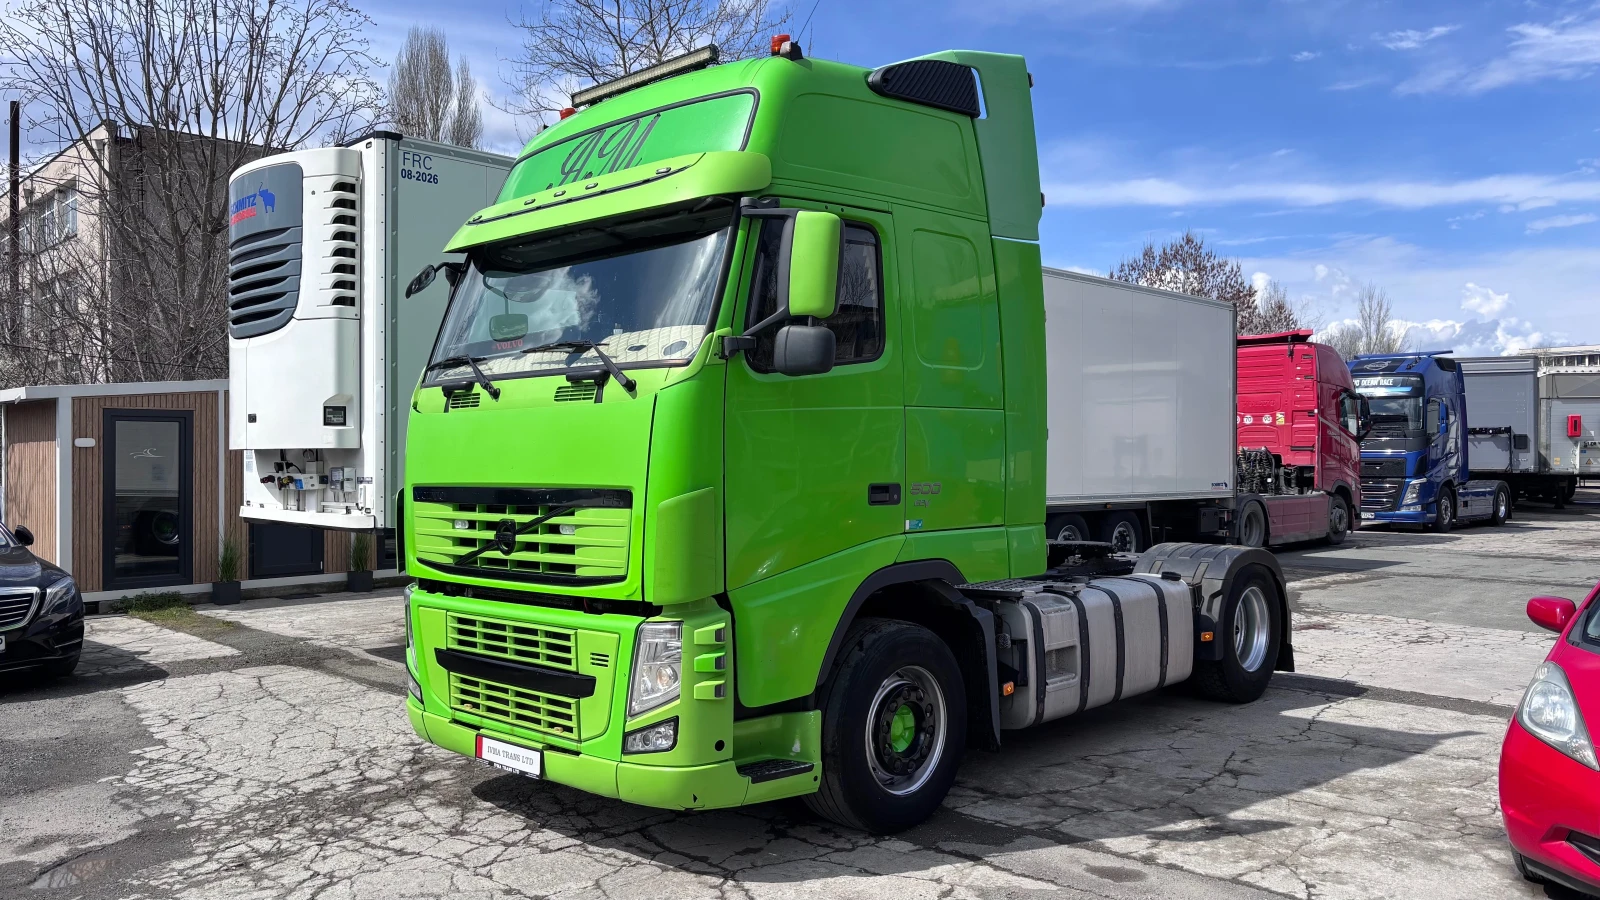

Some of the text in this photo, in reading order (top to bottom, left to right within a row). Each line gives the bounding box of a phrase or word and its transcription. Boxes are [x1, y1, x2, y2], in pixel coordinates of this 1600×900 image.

[402, 152, 433, 170] FRC
[401, 168, 438, 184] 08-2026
[496, 339, 523, 350] VOLVO
[910, 482, 941, 495] 500
[502, 750, 520, 761] TRANS
[522, 755, 534, 766] LTD
